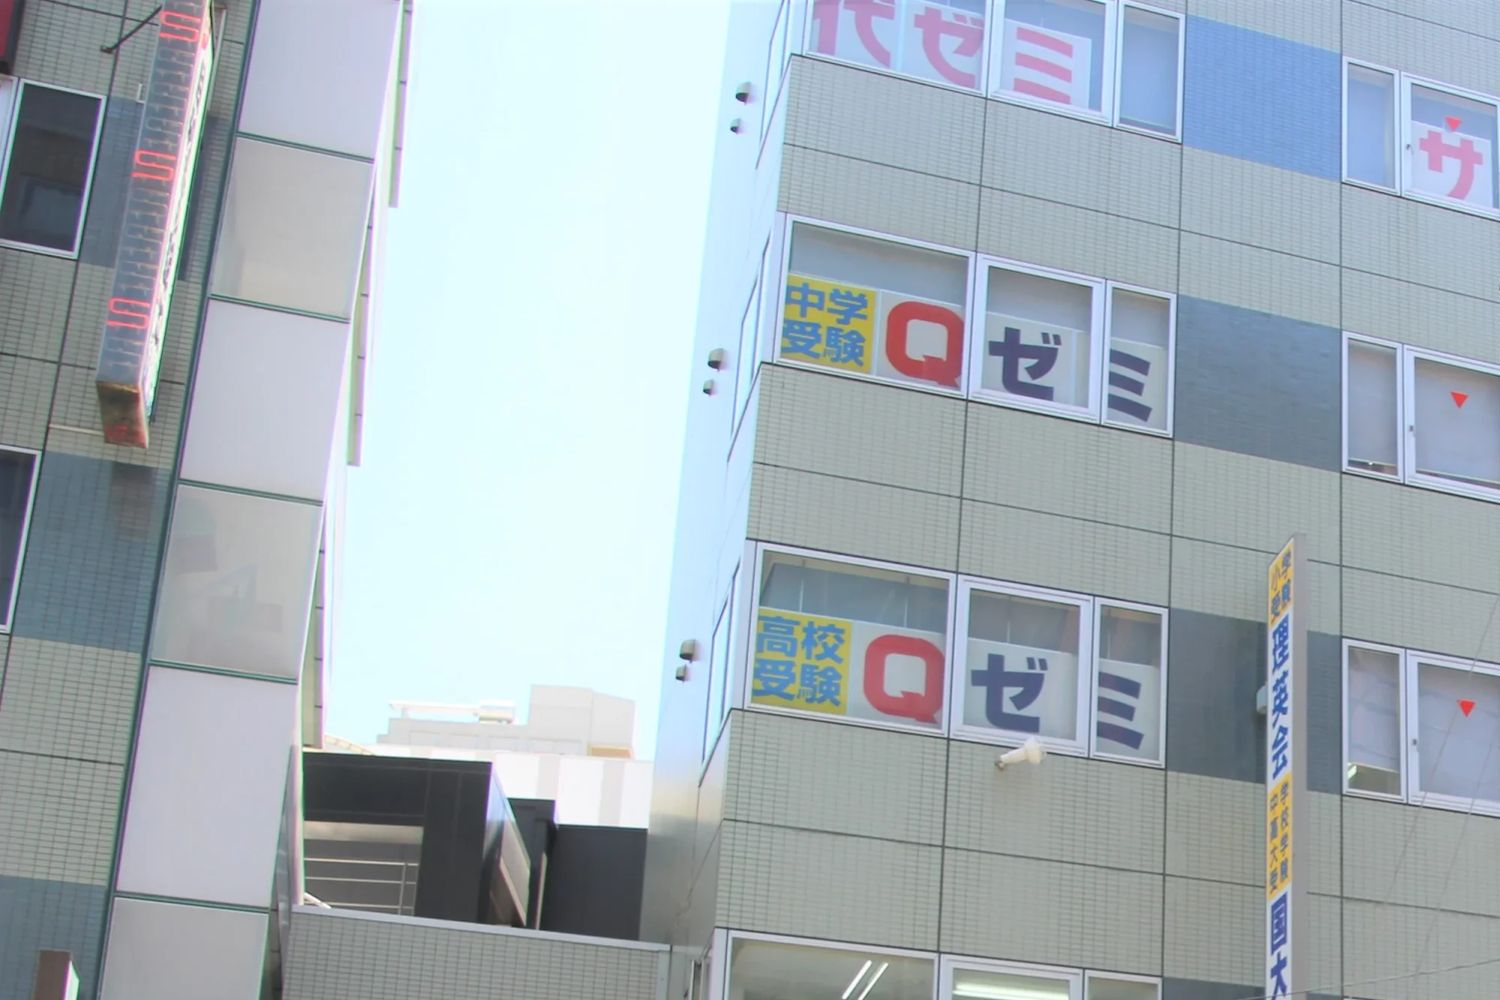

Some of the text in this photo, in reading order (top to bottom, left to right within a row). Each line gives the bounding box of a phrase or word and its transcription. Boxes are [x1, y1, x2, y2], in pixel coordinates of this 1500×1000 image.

[786, 282, 868, 326] 中学
[780, 319, 867, 368] 受験
[755, 615, 844, 665] 高校
[752, 657, 842, 707] 受験
